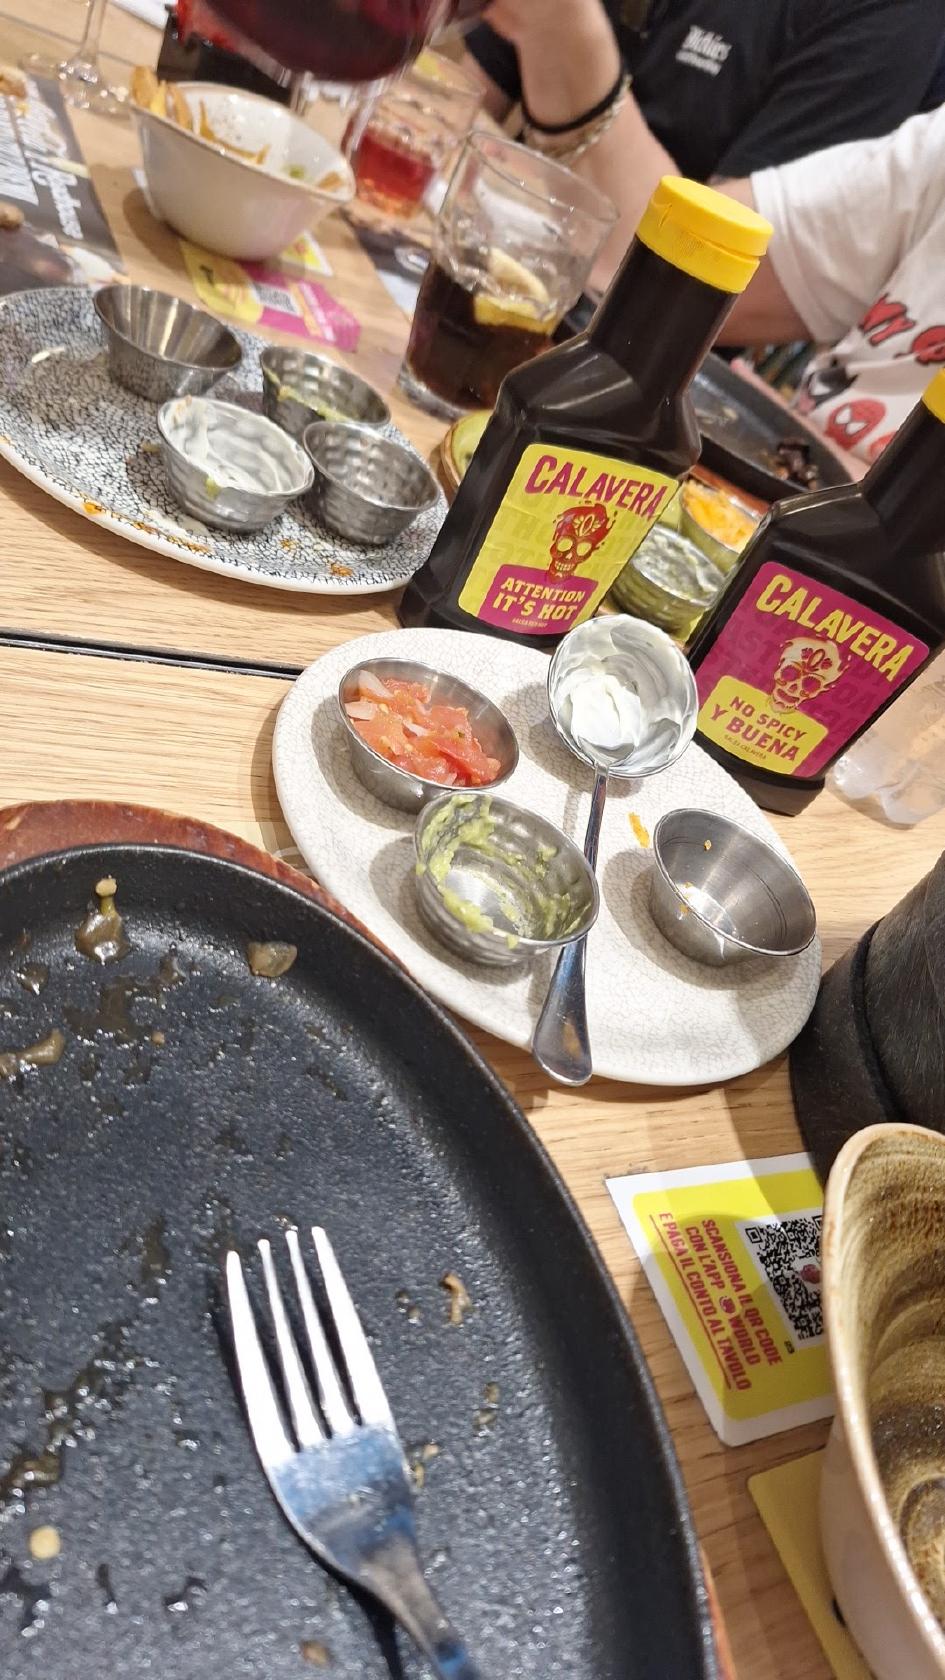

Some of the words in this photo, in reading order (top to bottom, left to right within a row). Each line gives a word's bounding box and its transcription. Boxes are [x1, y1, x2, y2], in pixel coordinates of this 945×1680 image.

[524, 454, 668, 519] CALAVERA
[492, 593, 536, 615] IT'S
[538, 603, 578, 621] HOT
[501, 577, 585, 602] ATTENTION
[756, 574, 914, 682] CALAVERA
[710, 703, 729, 722] Y
[726, 716, 800, 762] BUENA
[730, 696, 754, 716] NO
[756, 714, 808, 742] SPICY
[659, 1212, 673, 1221] E
[664, 1222, 687, 1257] PAGA
[680, 1256, 695, 1274] IL
[686, 1227, 708, 1256] CON
[698, 1253, 726, 1291] L'APP
[728, 1315, 761, 1365] WORLD
[687, 1273, 717, 1316] CONTO
[702, 1219, 746, 1293] SCANSIONA
[739, 1292, 753, 1308] IL
[746, 1307, 764, 1328] QR
[756, 1329, 783, 1366] CODE
[706, 1318, 726, 1334] AL
[717, 1338, 752, 1391] TAVOLO
